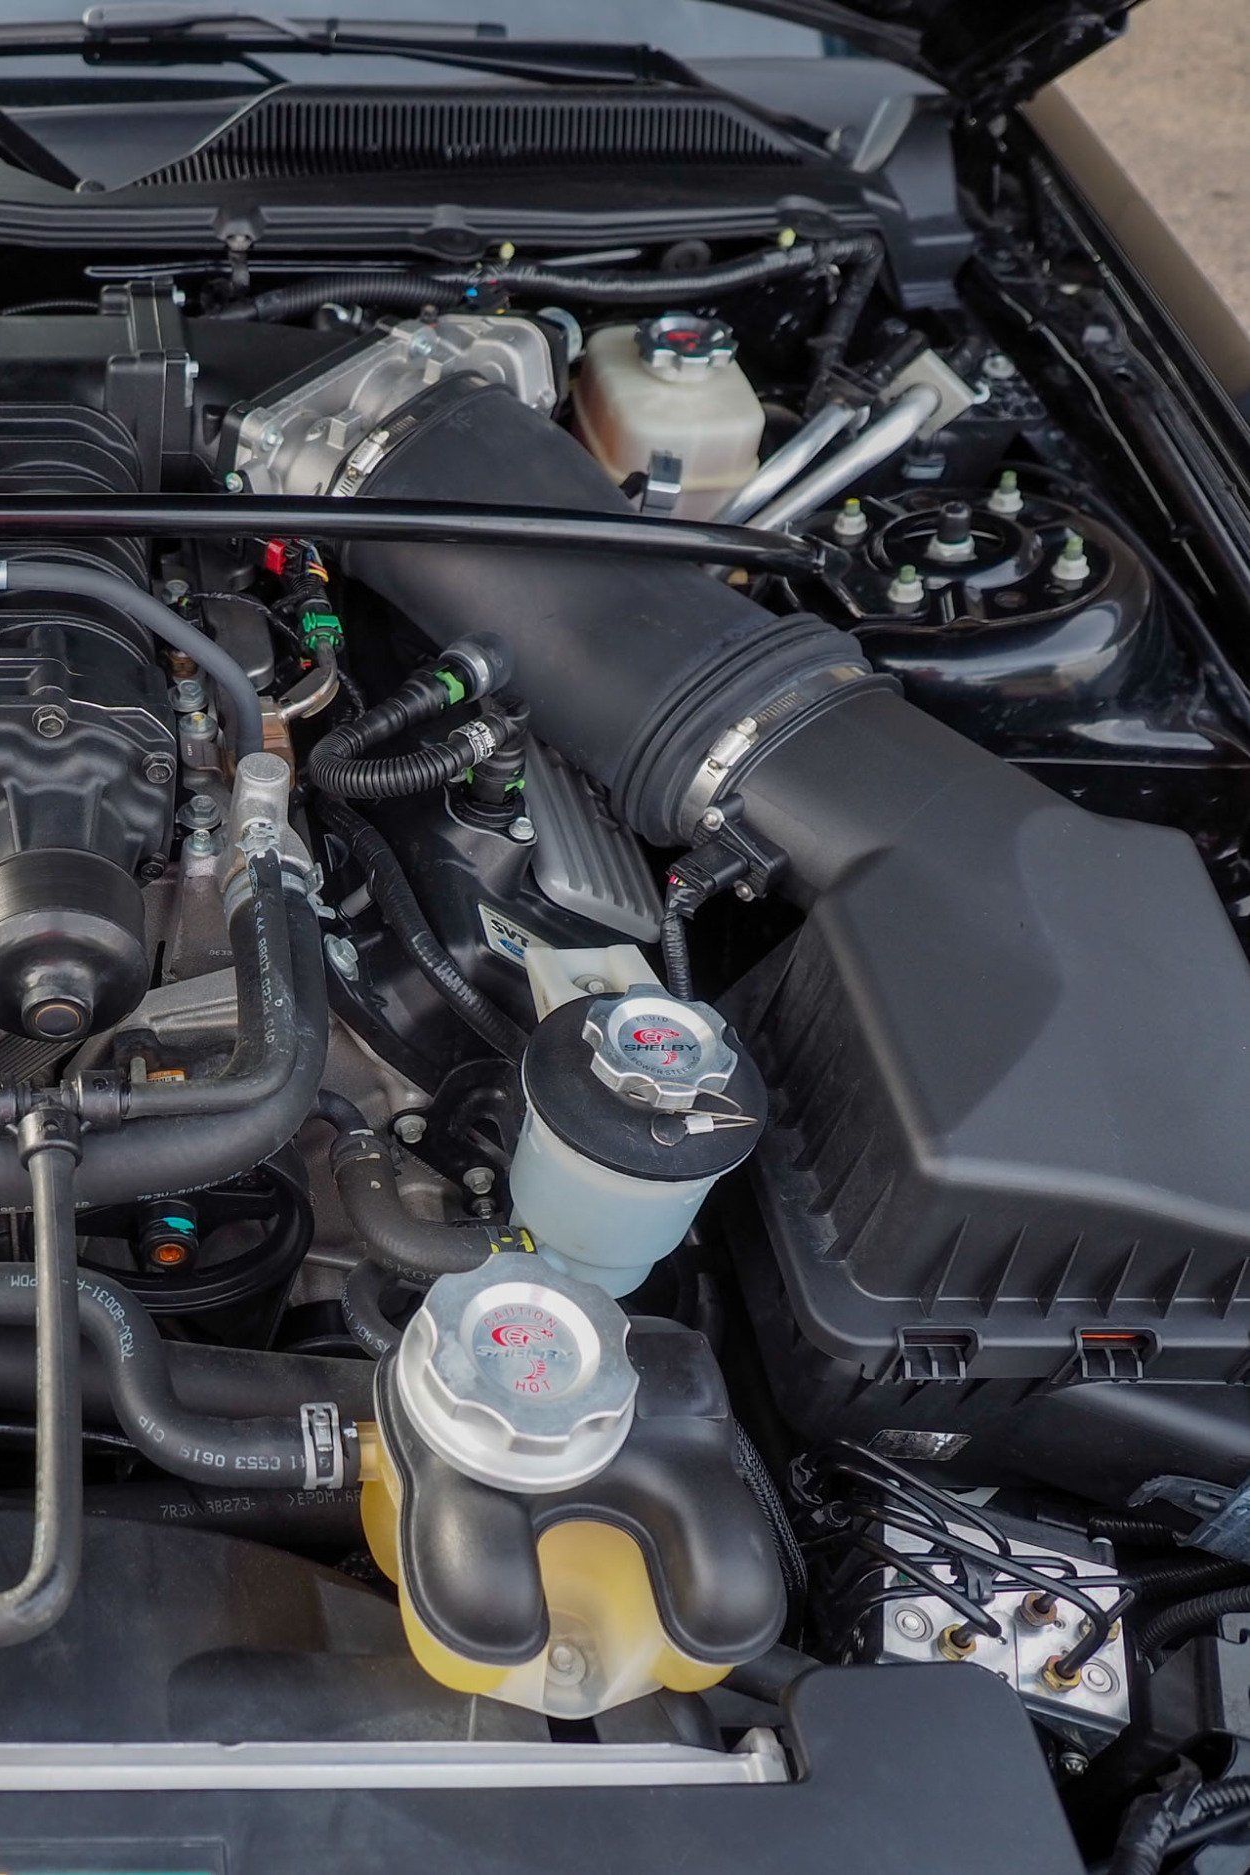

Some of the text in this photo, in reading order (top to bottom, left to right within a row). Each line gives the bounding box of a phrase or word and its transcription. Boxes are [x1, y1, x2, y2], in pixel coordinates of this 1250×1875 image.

[491, 918, 529, 948] SVT
[624, 1044, 698, 1052] SHELBY
[483, 1306, 558, 1329] CAUTION
[475, 1345, 574, 1360] SHELBY
[514, 1380, 551, 1393] HOT
